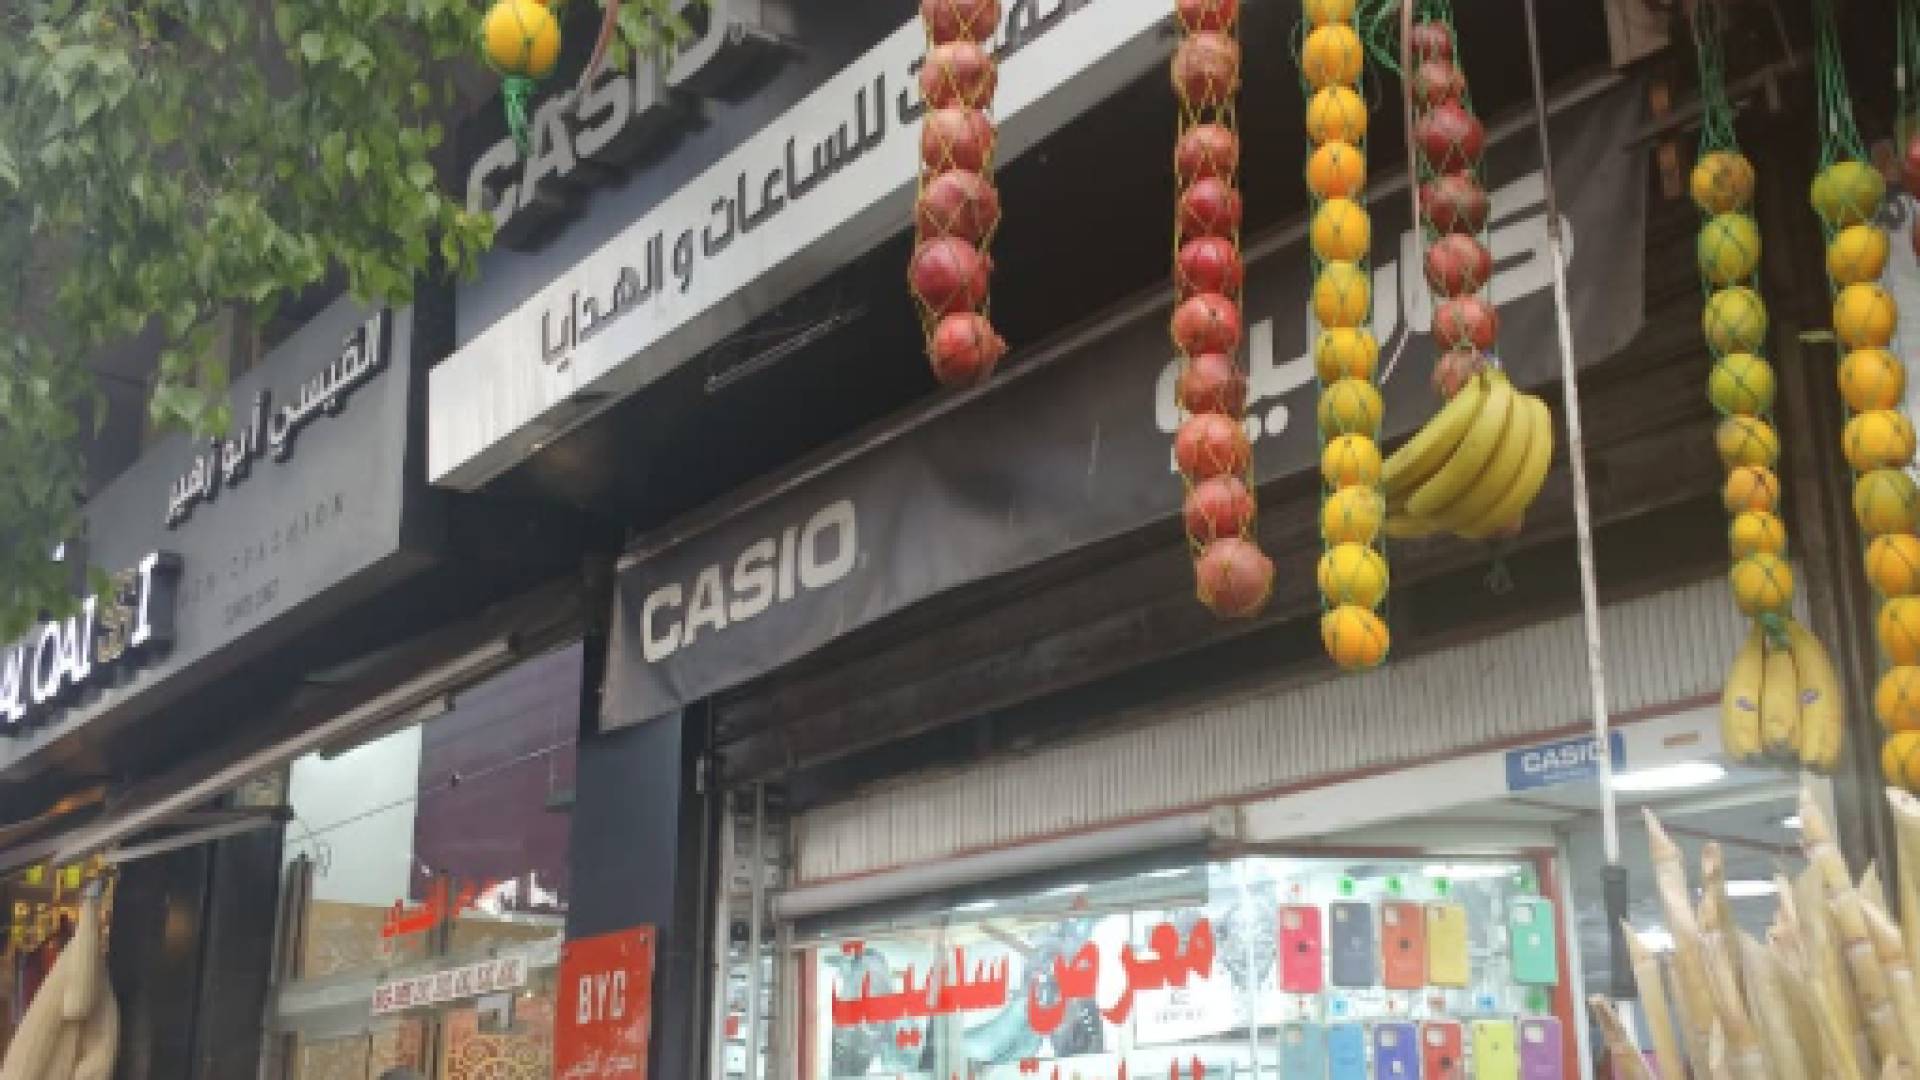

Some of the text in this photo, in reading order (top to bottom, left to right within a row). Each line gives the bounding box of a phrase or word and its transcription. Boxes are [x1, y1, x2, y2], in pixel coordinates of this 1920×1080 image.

[540, 75, 886, 372] للساعات و الهدايا
[269, 311, 382, 456] القيسي
[641, 499, 856, 663] CASIO
[575, 967, 627, 1025] BYC
[1026, 894, 1216, 1036] معرض
